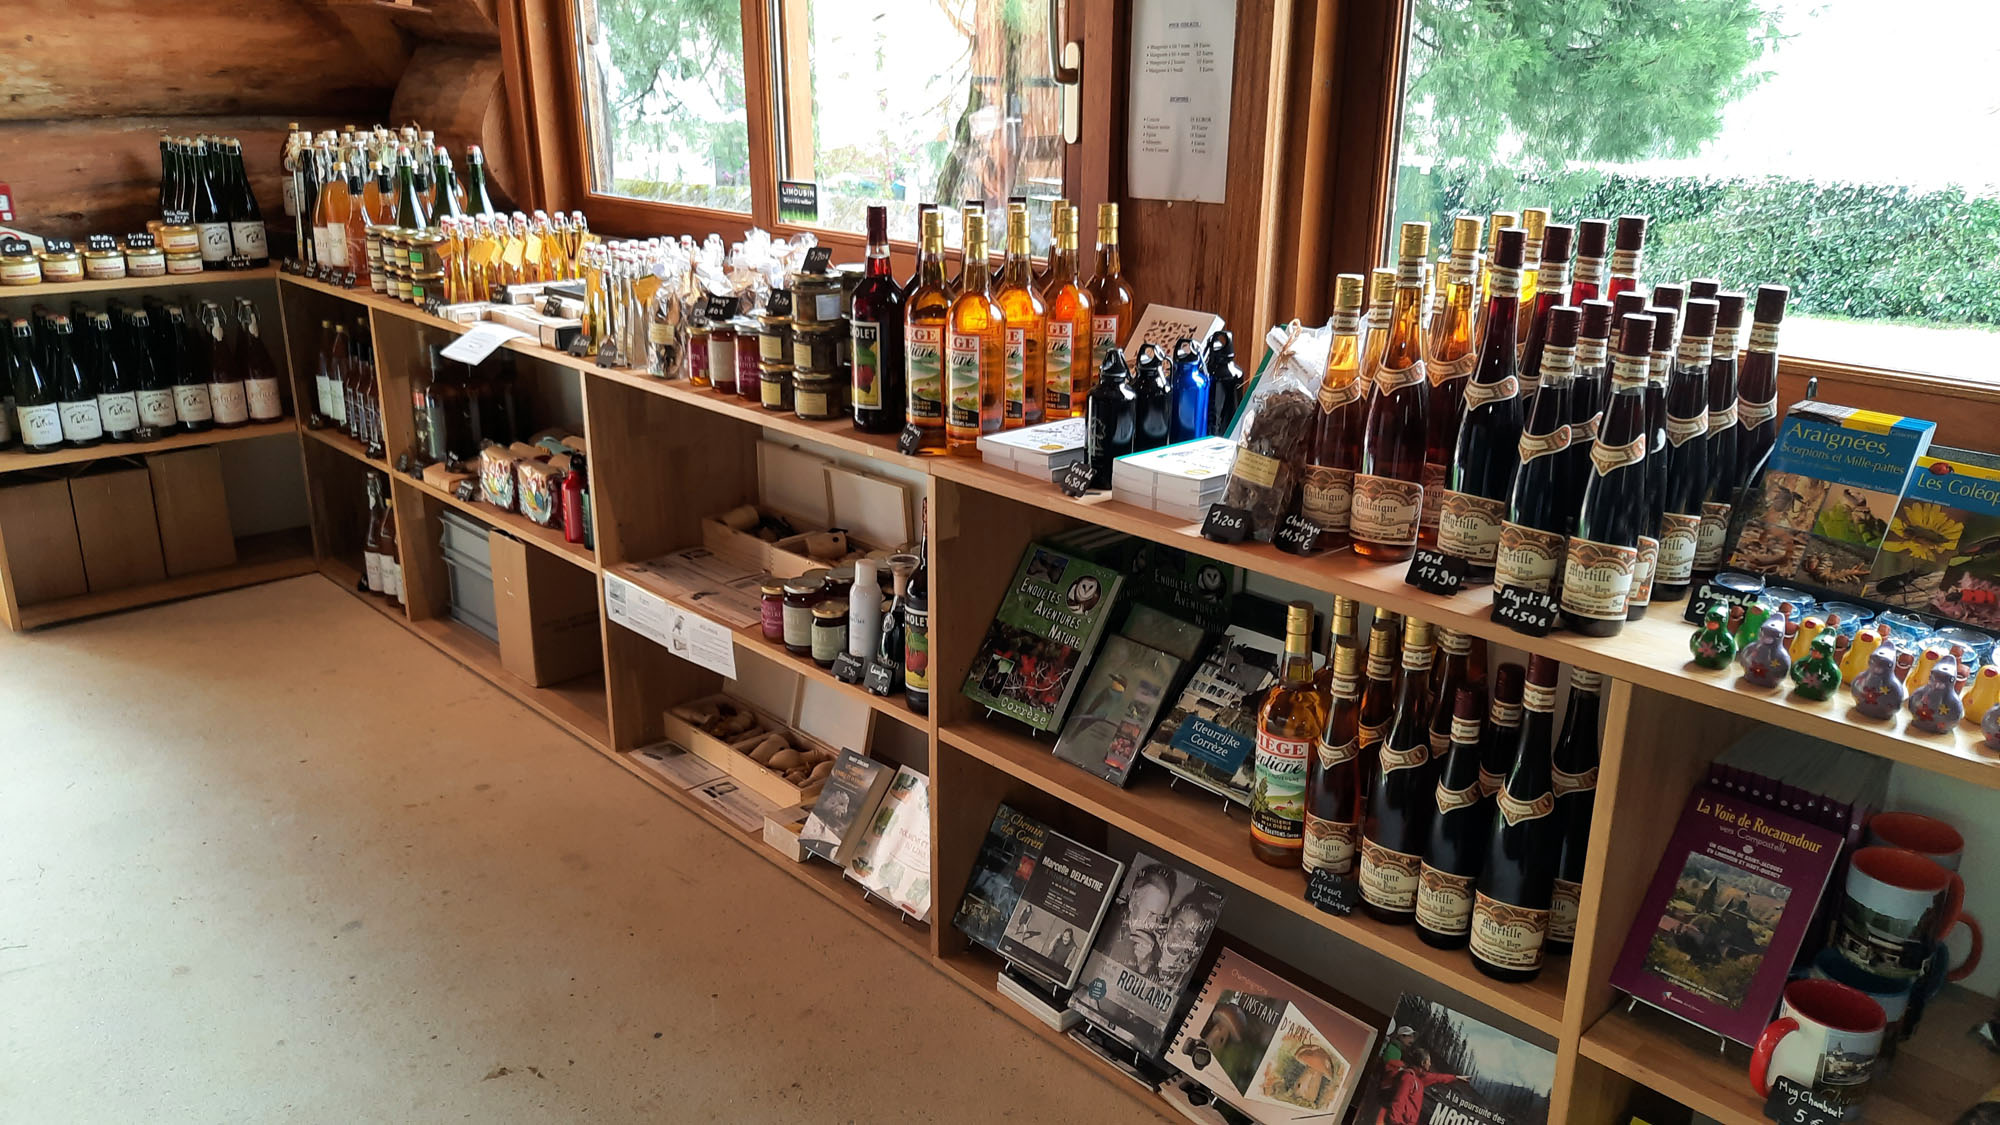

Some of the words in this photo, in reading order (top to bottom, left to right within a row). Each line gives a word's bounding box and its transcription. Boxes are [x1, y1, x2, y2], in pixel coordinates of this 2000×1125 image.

[782, 187, 815, 198] LIMOUSIN
[1786, 422, 1891, 459] Araignées,
[1780, 441, 1829, 461] Scorpions
[1832, 454, 1843, 464] et
[1844, 455, 1906, 475] Mille-pattes
[1917, 472, 1942, 491] Les
[1418, 566, 1457, 586] 17,90
[1568, 564, 1612, 582] Myrtille
[1501, 588, 1559, 614] Myrtille
[1000, 696, 1047, 726] Corrèze
[1190, 733, 1229, 757] Corrèze
[1192, 720, 1241, 749] Kleurrijke
[1010, 813, 1044, 838] Chemin
[1696, 797, 1711, 815] La
[1713, 803, 1736, 824] Voie
[1737, 813, 1751, 829] de
[1752, 817, 1823, 854] Rocamadour
[1737, 827, 1788, 855] Compostelle
[1041, 855, 1070, 876] Marcelle
[1069, 869, 1104, 892] DELPASTRE
[1481, 917, 1522, 939] Myrtille
[1506, 938, 1522, 949] Pays
[1116, 969, 1172, 1013] ROULAND
[1239, 990, 1280, 1026] L'INSTANT
[1779, 1080, 1799, 1106] Mug
[1452, 1093, 1459, 1104] la
[1459, 1098, 1492, 1118] poursuite
[1491, 1112, 1506, 1125] des
[1793, 1108, 1808, 1123] 5
